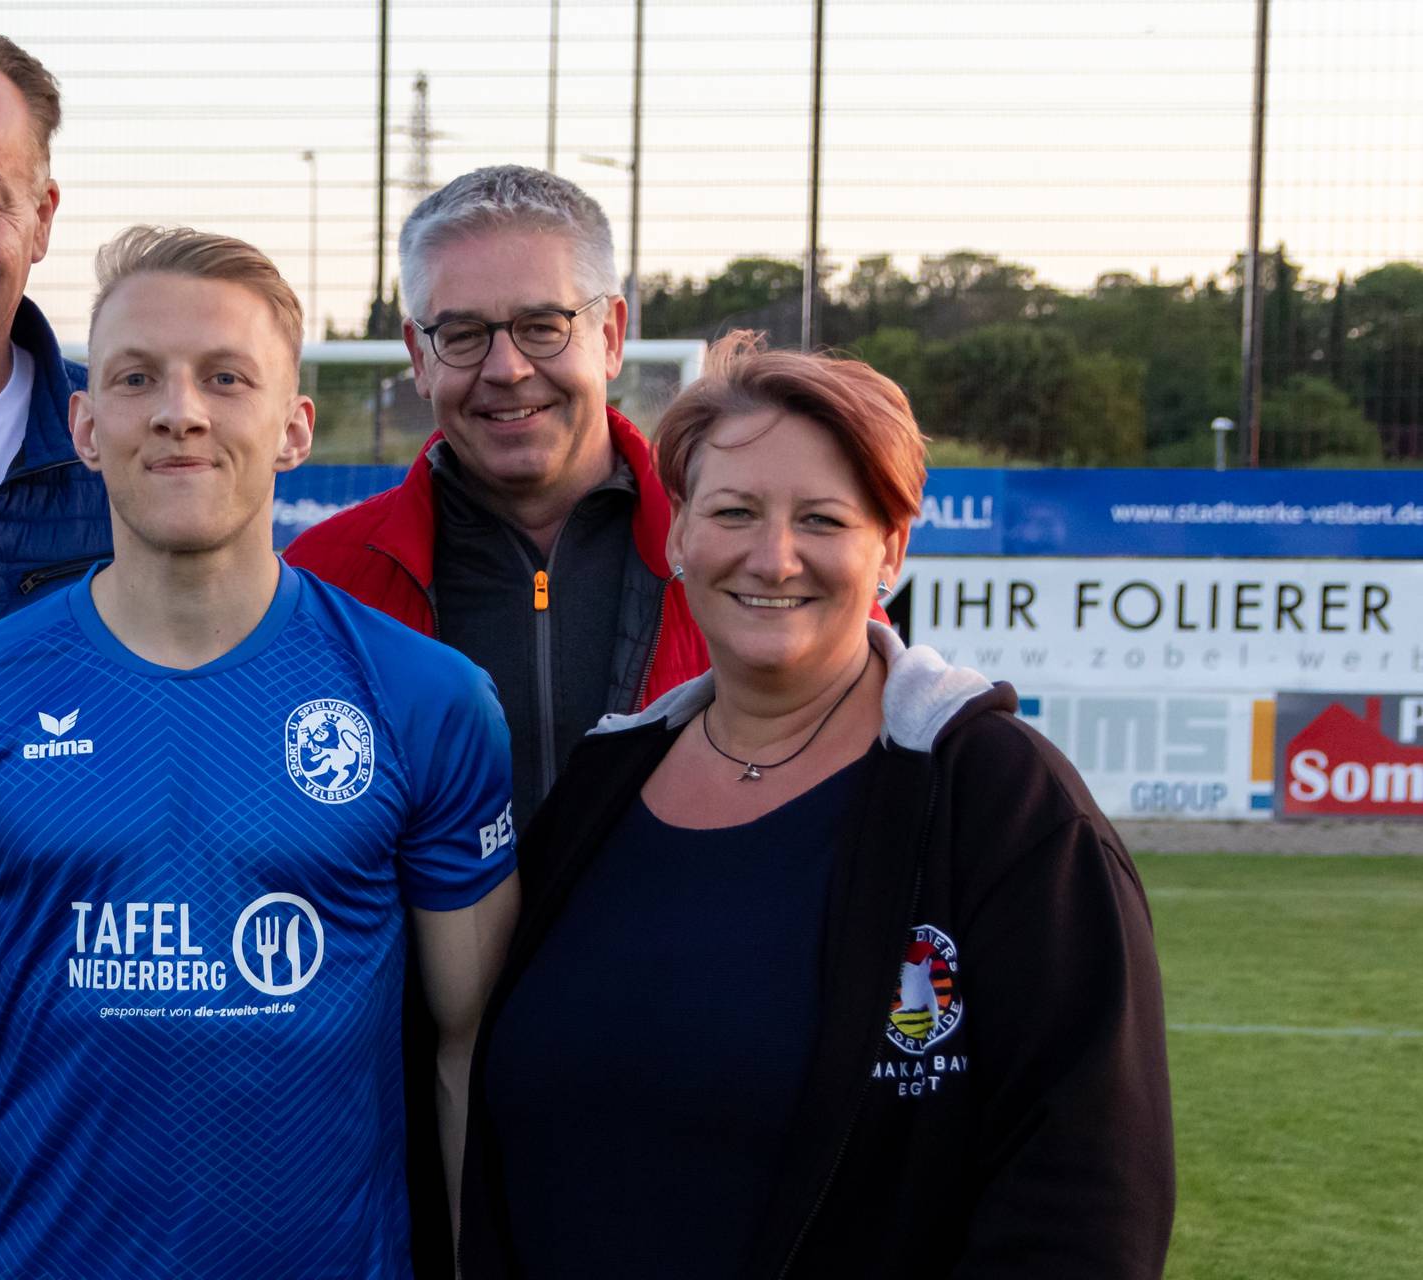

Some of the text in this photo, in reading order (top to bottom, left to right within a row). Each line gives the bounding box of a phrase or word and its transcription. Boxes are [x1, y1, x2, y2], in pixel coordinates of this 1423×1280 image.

[931, 579, 1393, 634] IHR FOLIERER
[23, 738, 94, 760] erima
[288, 742, 303, 777] SPORT
[297, 701, 370, 764] SPIELVEREINIGUNG
[358, 768, 369, 783] 02
[305, 781, 357, 800] VELBERT
[1130, 782, 1228, 812] GROUP
[71, 901, 203, 956] TAFEL
[68, 958, 227, 991] NIEDERBERG
[100, 1003, 296, 1019] gesponsert von die-zweite-elf.de
[934, 1055, 968, 1071] BAY
